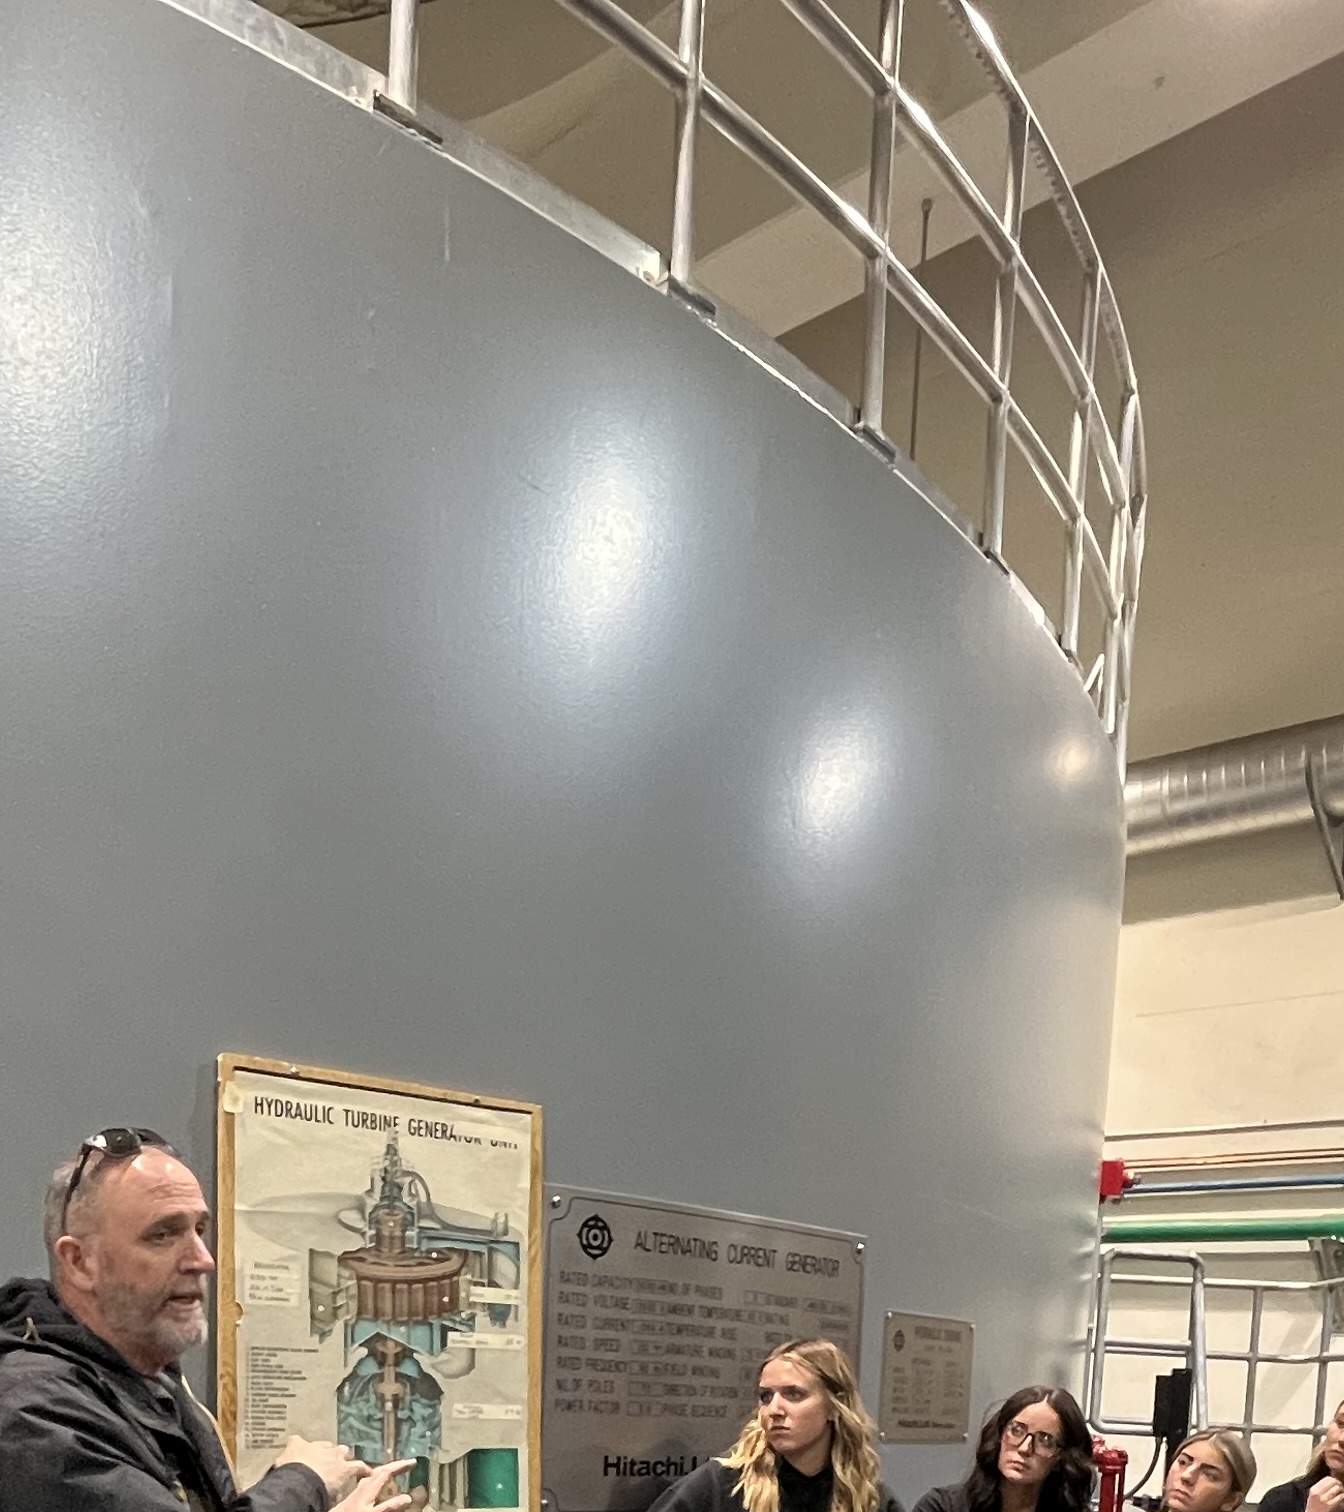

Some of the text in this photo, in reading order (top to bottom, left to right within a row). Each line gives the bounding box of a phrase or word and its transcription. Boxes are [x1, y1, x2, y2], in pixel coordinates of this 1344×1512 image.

[254, 1096, 334, 1124] HYDRAULIC
[343, 1108, 400, 1132] TURBINE
[634, 1231, 840, 1278] ALTERNATING CURRENT GENERATOR
